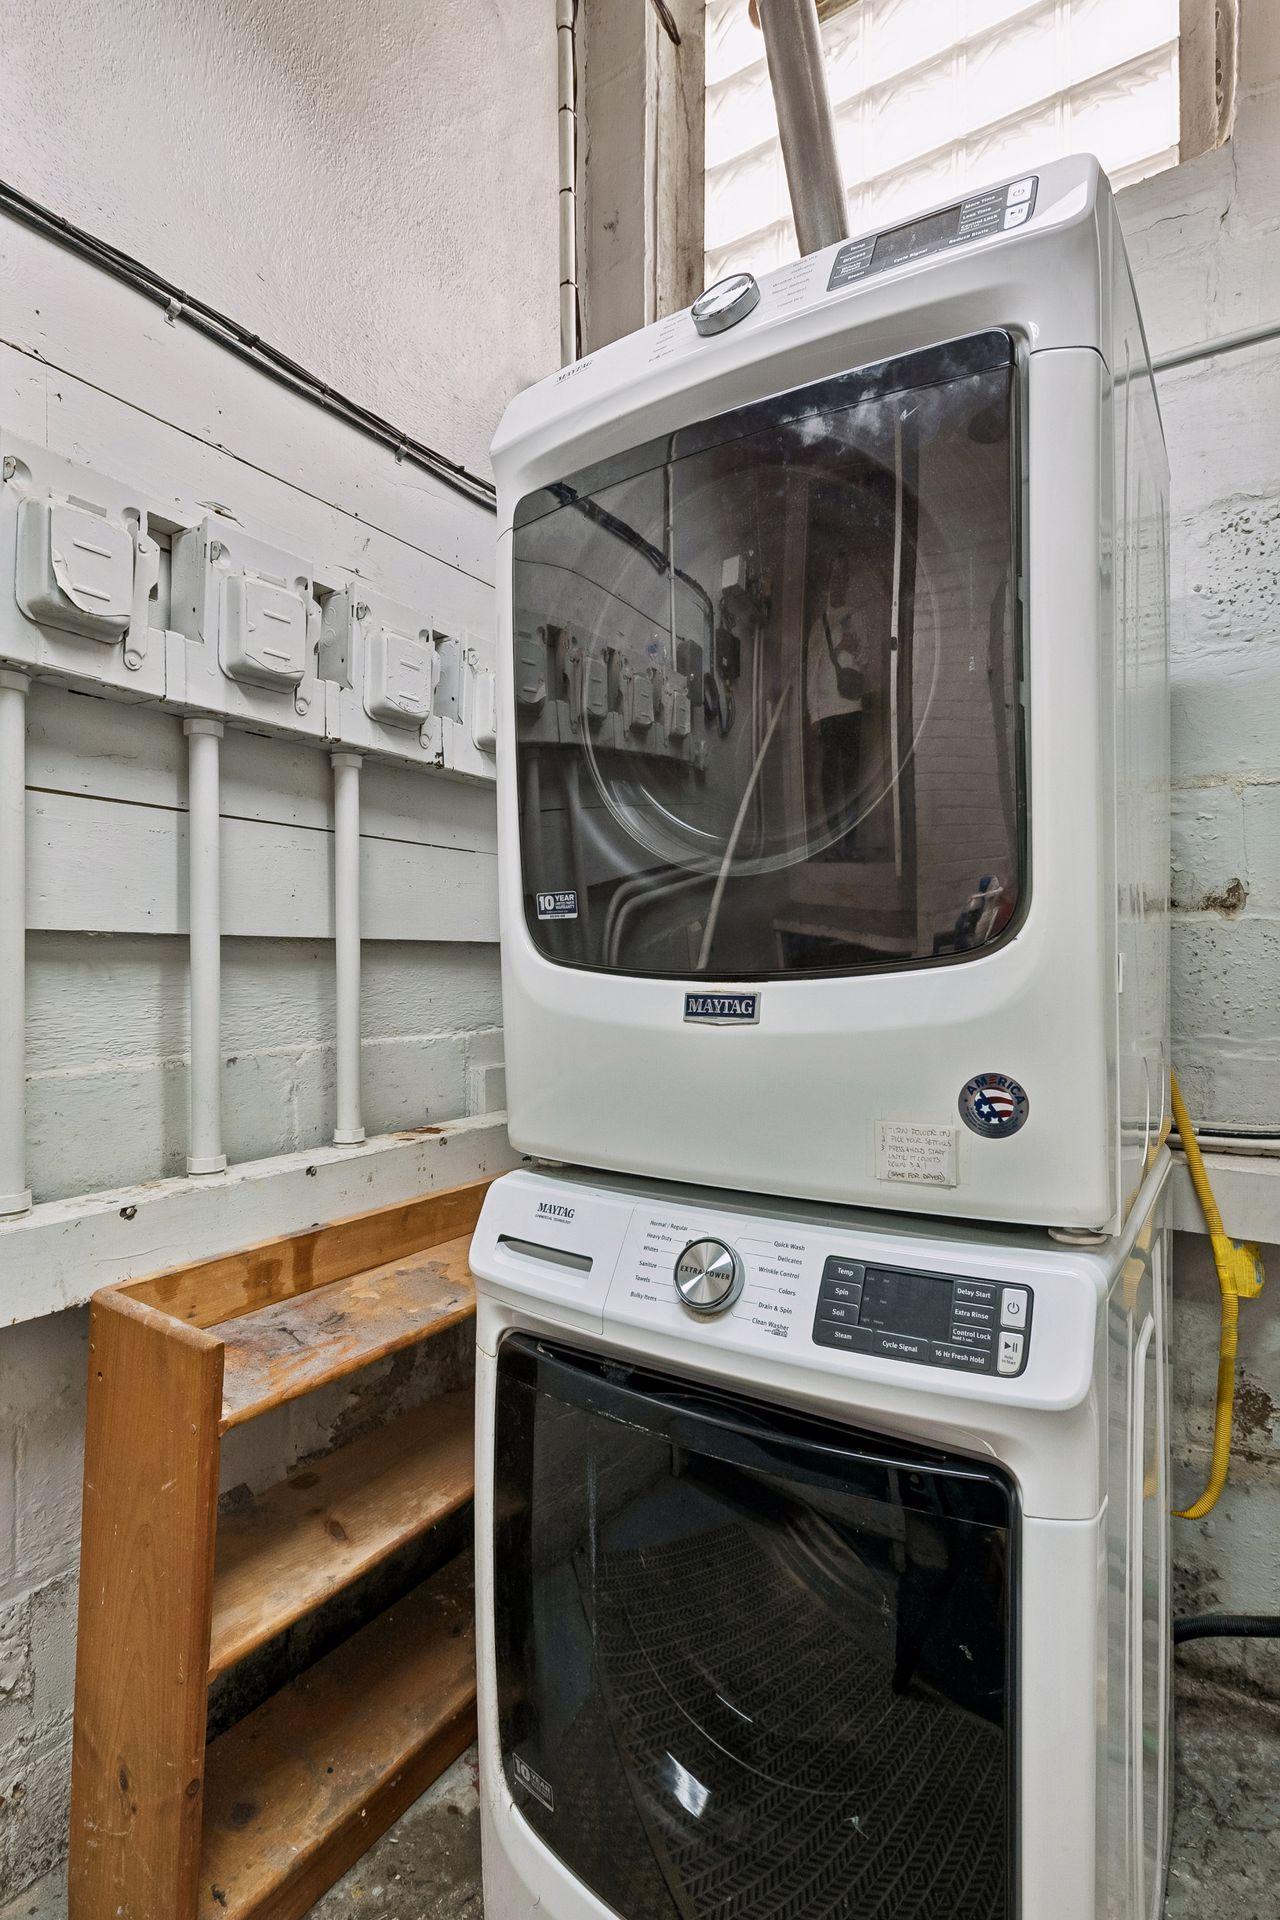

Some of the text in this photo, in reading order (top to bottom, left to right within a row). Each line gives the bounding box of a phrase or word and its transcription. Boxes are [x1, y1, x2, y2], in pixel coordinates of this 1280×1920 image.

[539, 895, 554, 911] 10
[688, 998, 753, 1014] MAYTAG
[967, 1076, 1026, 1105] AMERICA
[537, 1202, 575, 1219] MAYTAG
[650, 1220, 667, 1228] Normal
[671, 1223, 688, 1231] Regular
[643, 1245, 659, 1253] Whites
[774, 1241, 805, 1251] Quick Wash
[639, 1260, 658, 1268] Sanitize
[777, 1255, 802, 1265] Delicates
[680, 1265, 730, 1280] EXTRA POWER
[758, 1266, 800, 1279] Wrinkle Control
[837, 1267, 854, 1277] Temp
[635, 1275, 651, 1283] Towels
[630, 1291, 657, 1302] Bulky Items
[778, 1288, 796, 1296] Colors
[835, 1287, 849, 1296] Spin
[957, 1288, 991, 1299] Delay Start
[758, 1302, 773, 1310] Drain
[780, 1306, 793, 1315] Spin
[832, 1308, 845, 1317] Soil
[954, 1308, 989, 1320] Extra Rinse
[752, 1317, 789, 1331] Clean Washer
[834, 1331, 852, 1340] Steam
[952, 1328, 991, 1340] Control Lock
[882, 1340, 918, 1353] Cycle Signal
[943, 1350, 951, 1358] Hr
[951, 1352, 969, 1361] Fresh
[969, 1355, 985, 1365] Hold
[515, 1757, 531, 1782] 10
